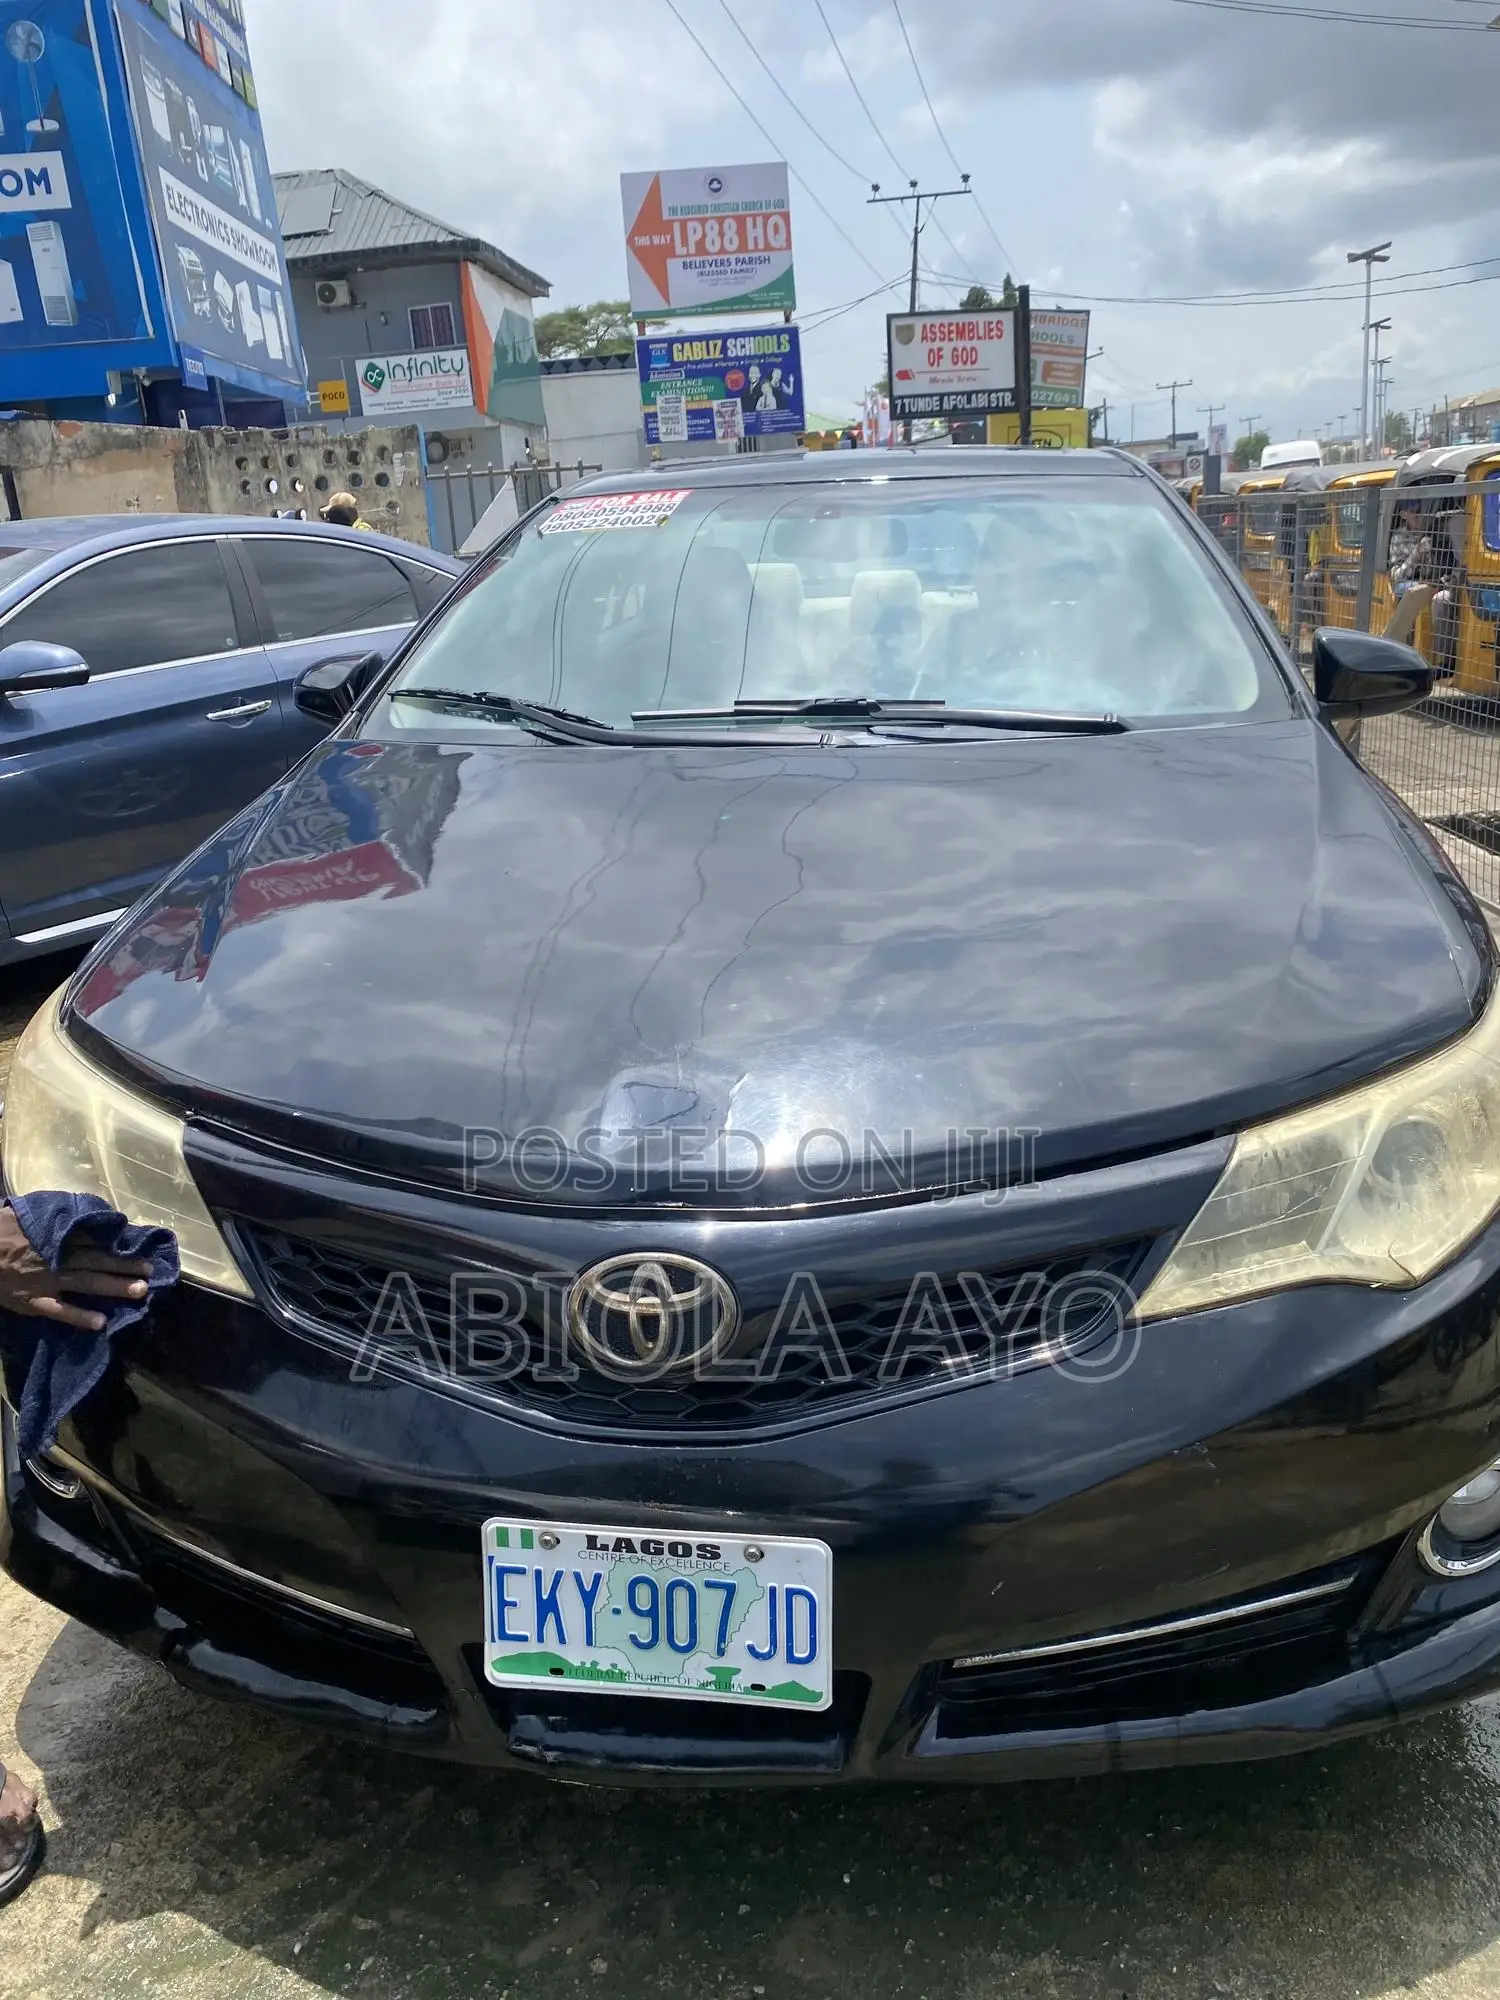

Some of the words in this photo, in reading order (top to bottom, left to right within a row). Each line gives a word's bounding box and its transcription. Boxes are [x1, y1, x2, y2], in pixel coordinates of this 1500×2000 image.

[0, 167, 53, 197] OM
[165, 183, 231, 247] ELECTRONICS
[230, 226, 278, 274] SHOWROOM
[633, 235, 650, 247] THIS
[651, 233, 671, 246] WAY
[672, 217, 740, 256] LP88
[745, 214, 788, 250] HQ
[682, 258, 732, 270] BELIEVERS
[735, 255, 771, 267] PARISH
[921, 319, 1004, 343] ASSEMBLIES
[672, 338, 724, 362] GABLIZ
[726, 333, 791, 358] SCHOOLS
[926, 347, 944, 368] OF
[951, 346, 979, 367] GOD
[660, 378, 703, 390] ENTRANCE
[321, 391, 346, 401] POCO
[902, 396, 941, 414] TUNDE
[942, 394, 989, 410] AFOLABI
[989, 391, 1016, 407] STR.
[634, 490, 691, 504] SALE
[585, 1534, 722, 1561] LAGOS
[577, 1550, 627, 1564] CENTRE
[628, 1554, 647, 1565] OF
[650, 1556, 732, 1572] EXCELLENCE
[568, 1666, 622, 1680] FEDERAL
[677, 1676, 693, 1686] OF
[695, 1679, 744, 1692] NIGERIA
